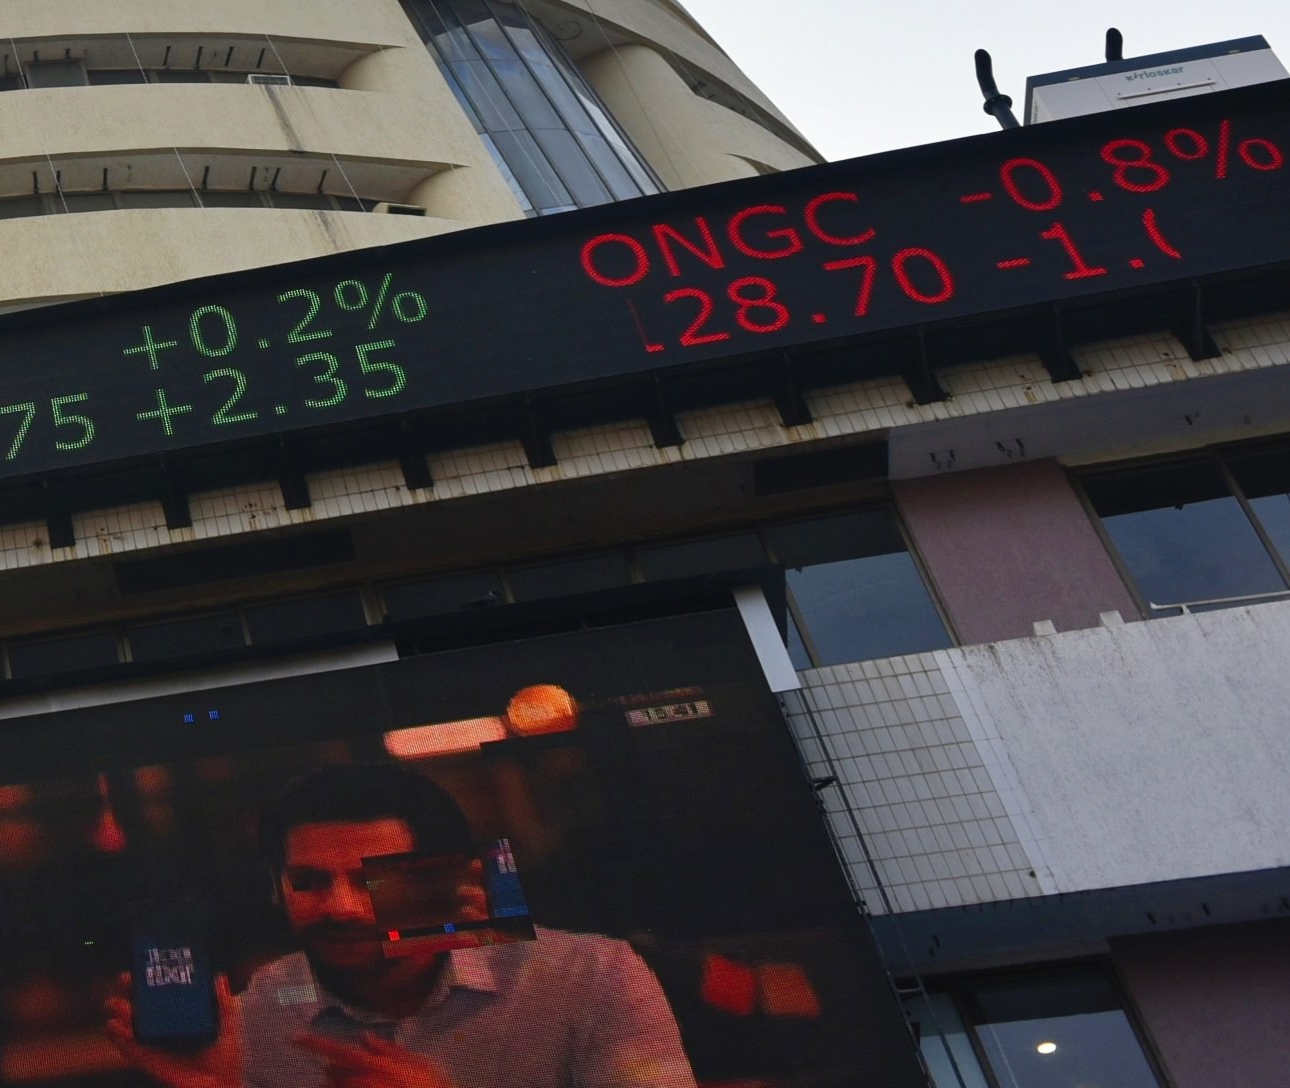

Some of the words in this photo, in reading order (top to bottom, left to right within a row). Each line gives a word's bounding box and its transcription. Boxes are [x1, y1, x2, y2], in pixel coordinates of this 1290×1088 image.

[580, 191, 876, 287] ONGC
[960, 120, 1283, 211] -0.8%
[123, 273, 429, 369] +0.2%
[136, 340, 408, 435] +2.35
